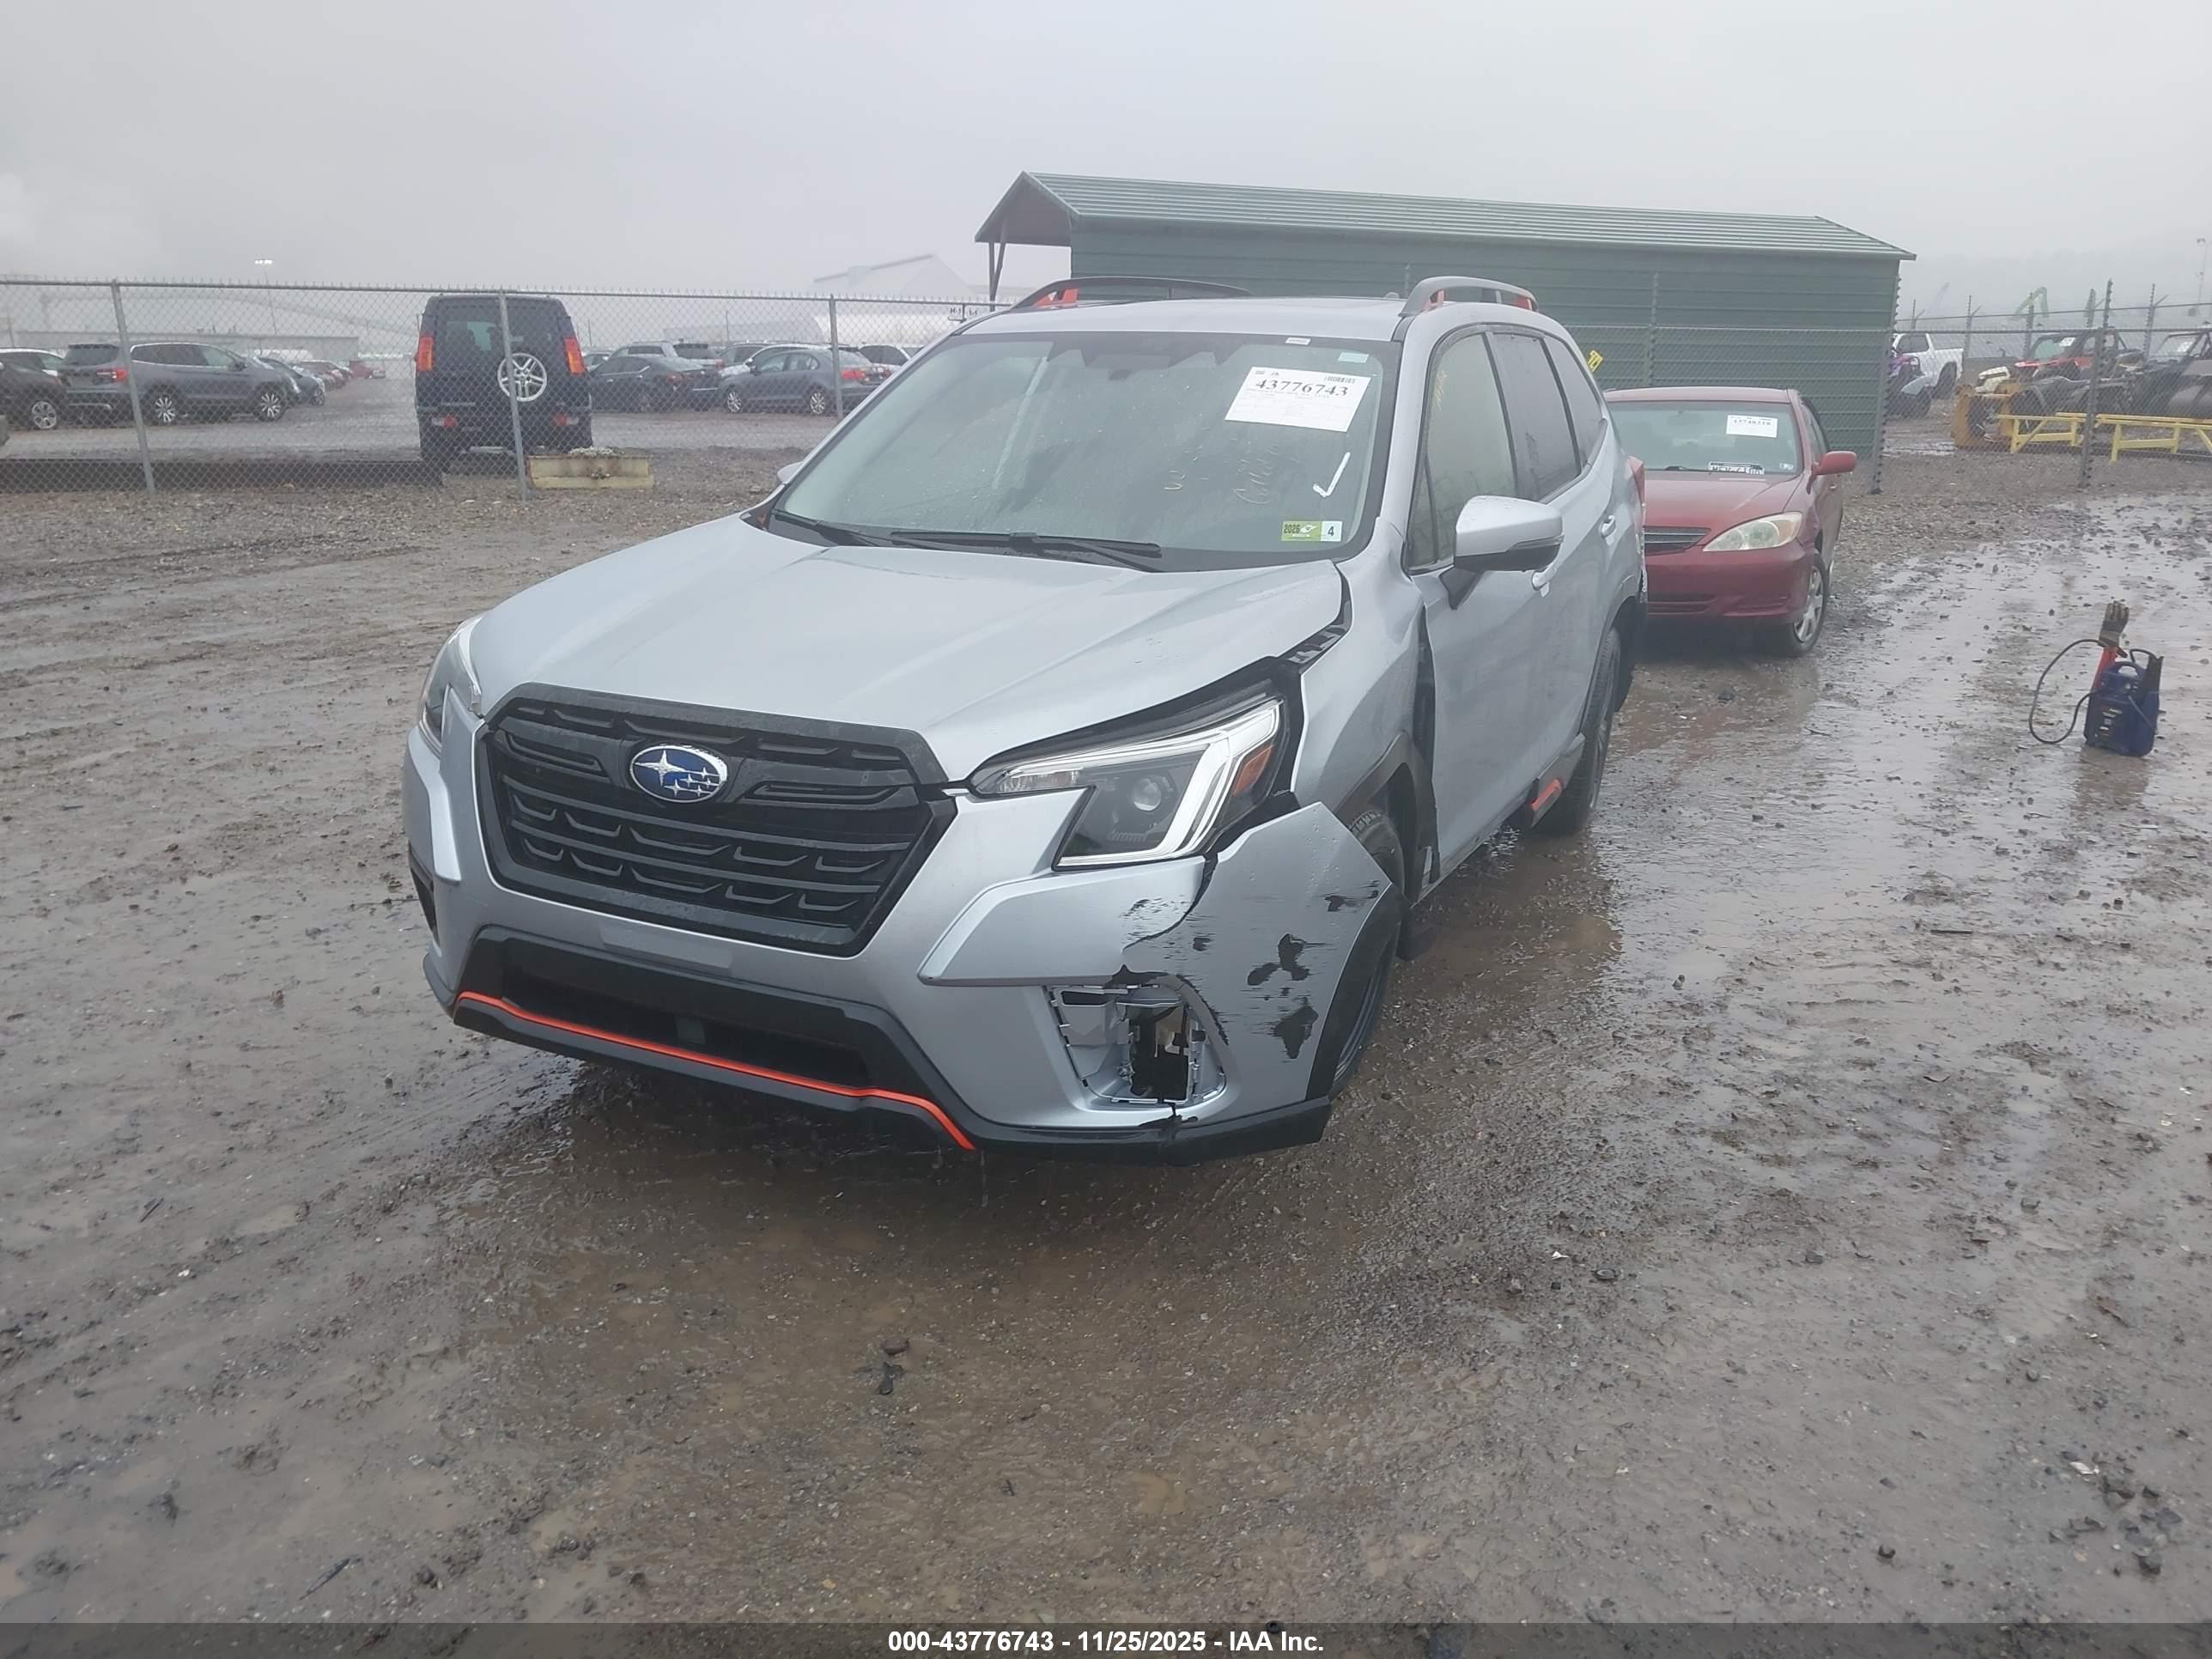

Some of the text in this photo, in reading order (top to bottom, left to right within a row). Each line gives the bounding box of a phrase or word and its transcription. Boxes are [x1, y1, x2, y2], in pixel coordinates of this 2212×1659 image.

[1255, 379, 1349, 397] 43776743
[1283, 524, 1301, 534] 2026
[1327, 526, 1335, 537] 4
